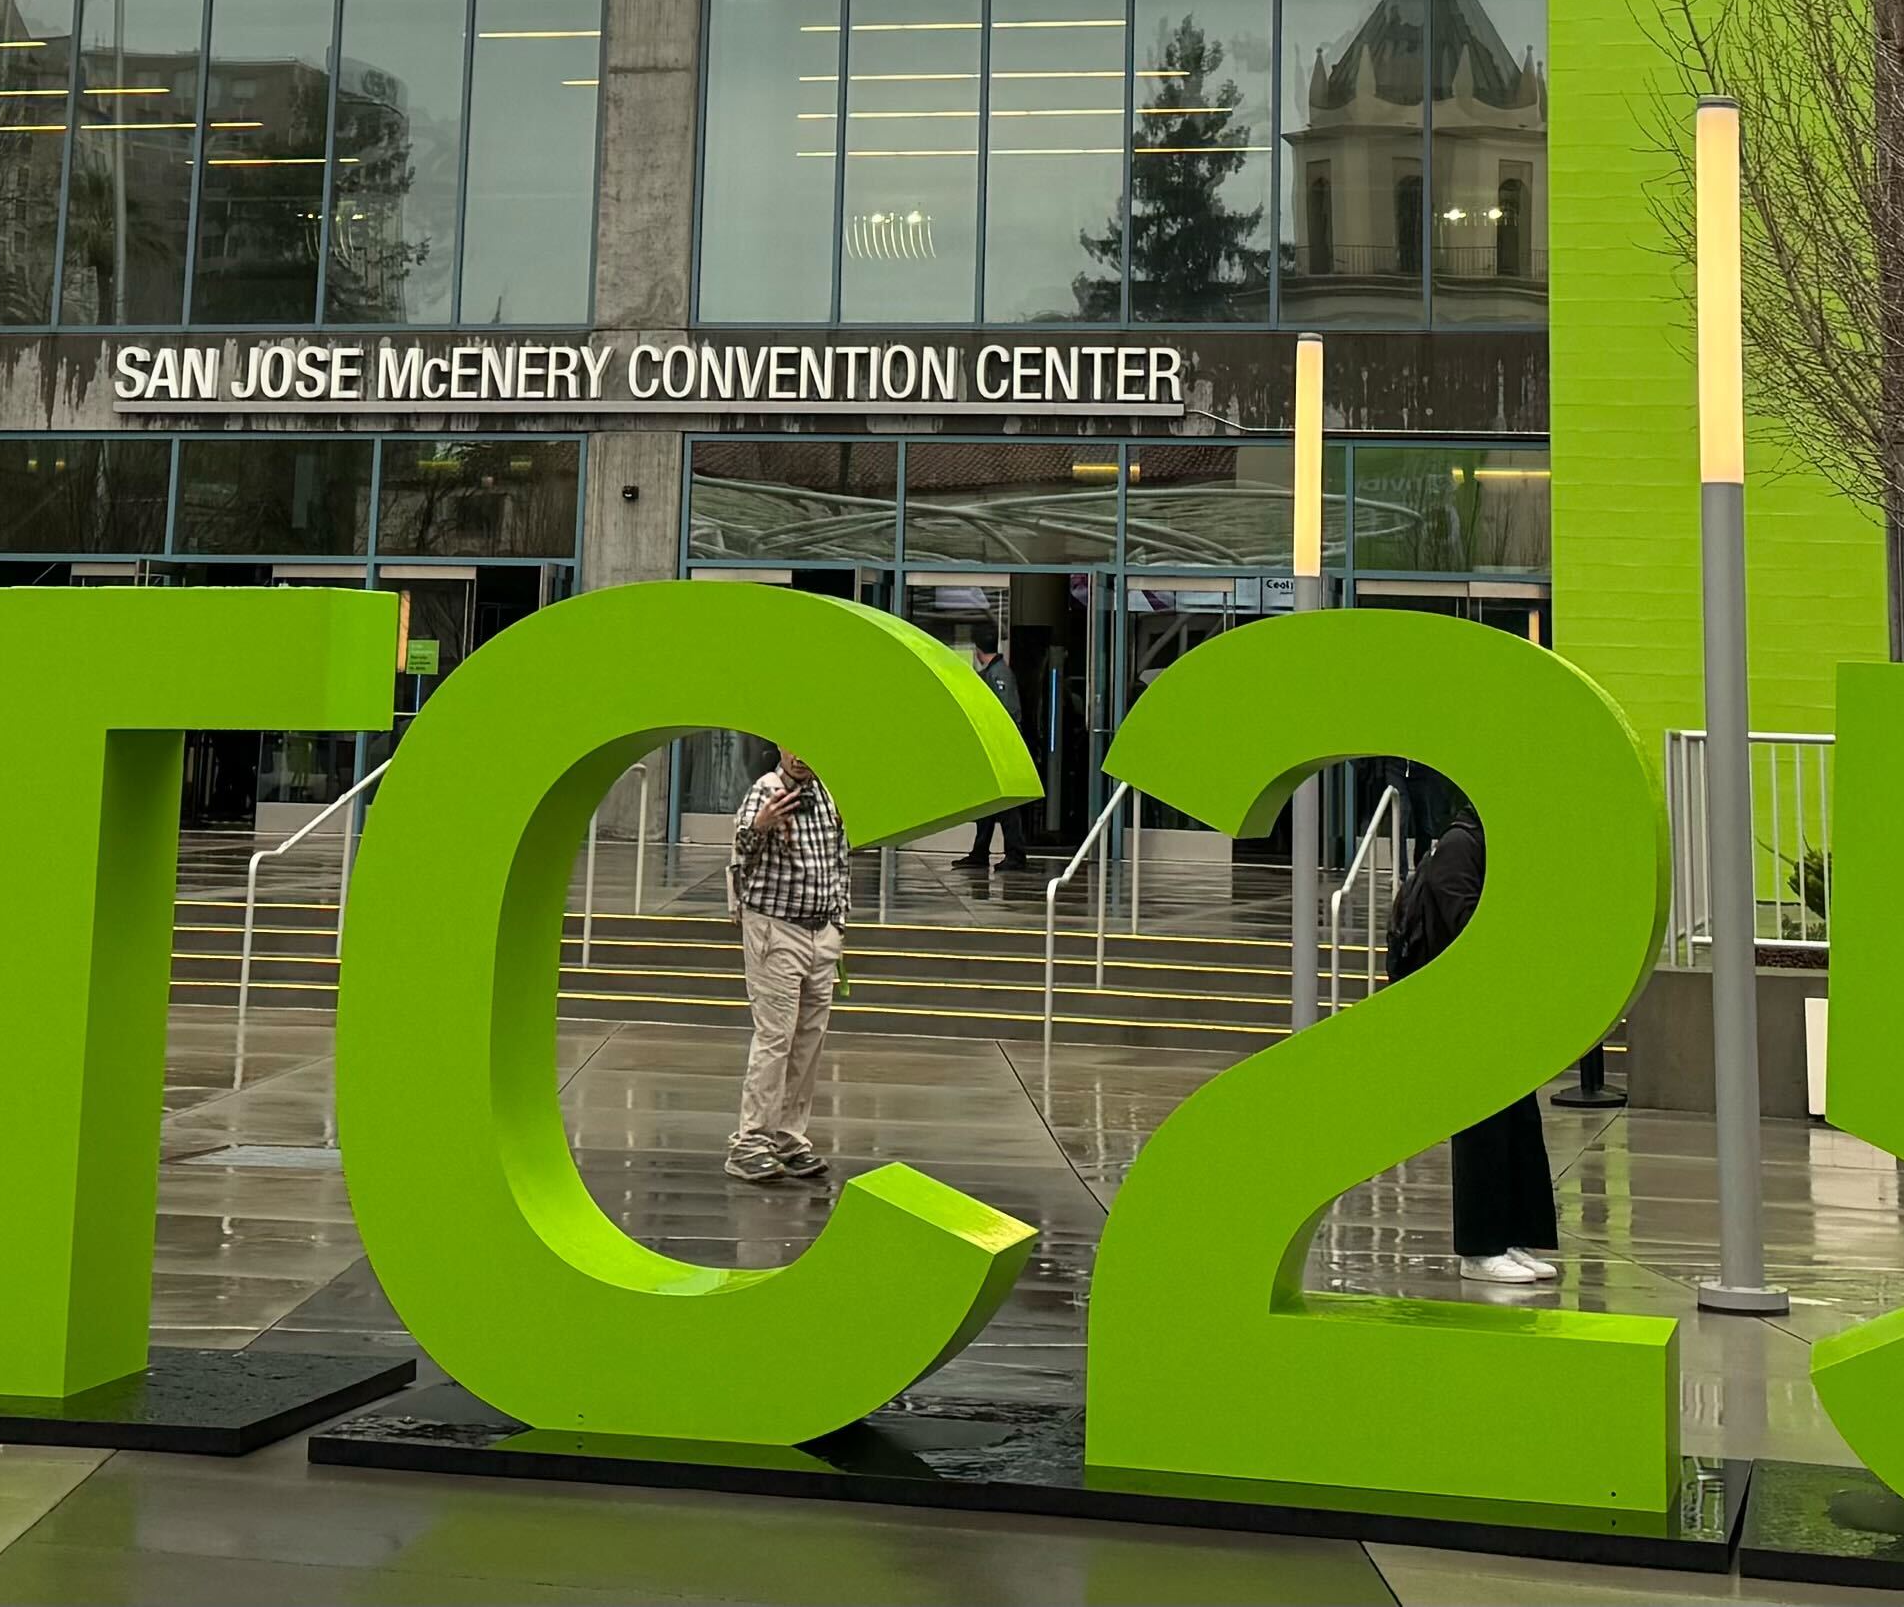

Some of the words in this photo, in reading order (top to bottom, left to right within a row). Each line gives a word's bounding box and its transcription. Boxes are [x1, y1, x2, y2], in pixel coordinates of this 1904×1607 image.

[114, 345, 220, 400] SAN
[230, 345, 364, 400] JOSE
[627, 344, 958, 400] CONVENTION
[975, 344, 1183, 402] CENTER
